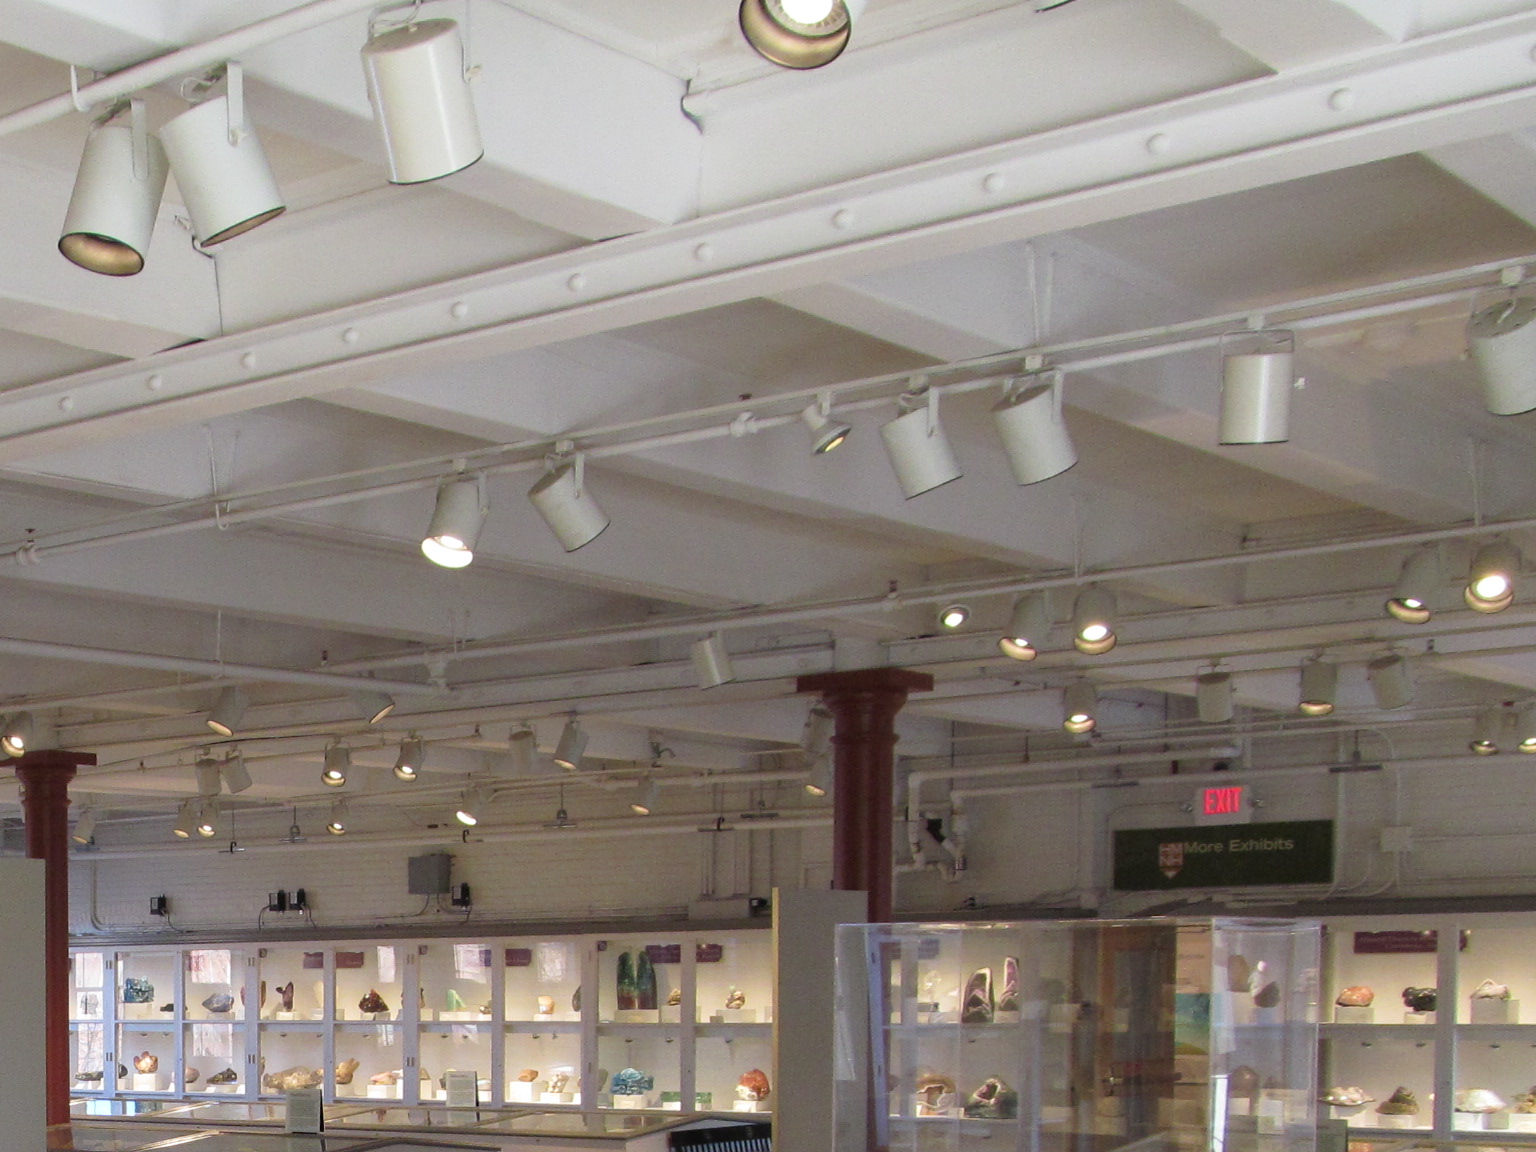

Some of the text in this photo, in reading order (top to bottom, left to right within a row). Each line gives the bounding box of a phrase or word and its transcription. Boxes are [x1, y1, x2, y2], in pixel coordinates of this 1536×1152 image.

[1203, 787, 1242, 815] EXIT
[1184, 837, 1294, 854] More Exhibits
